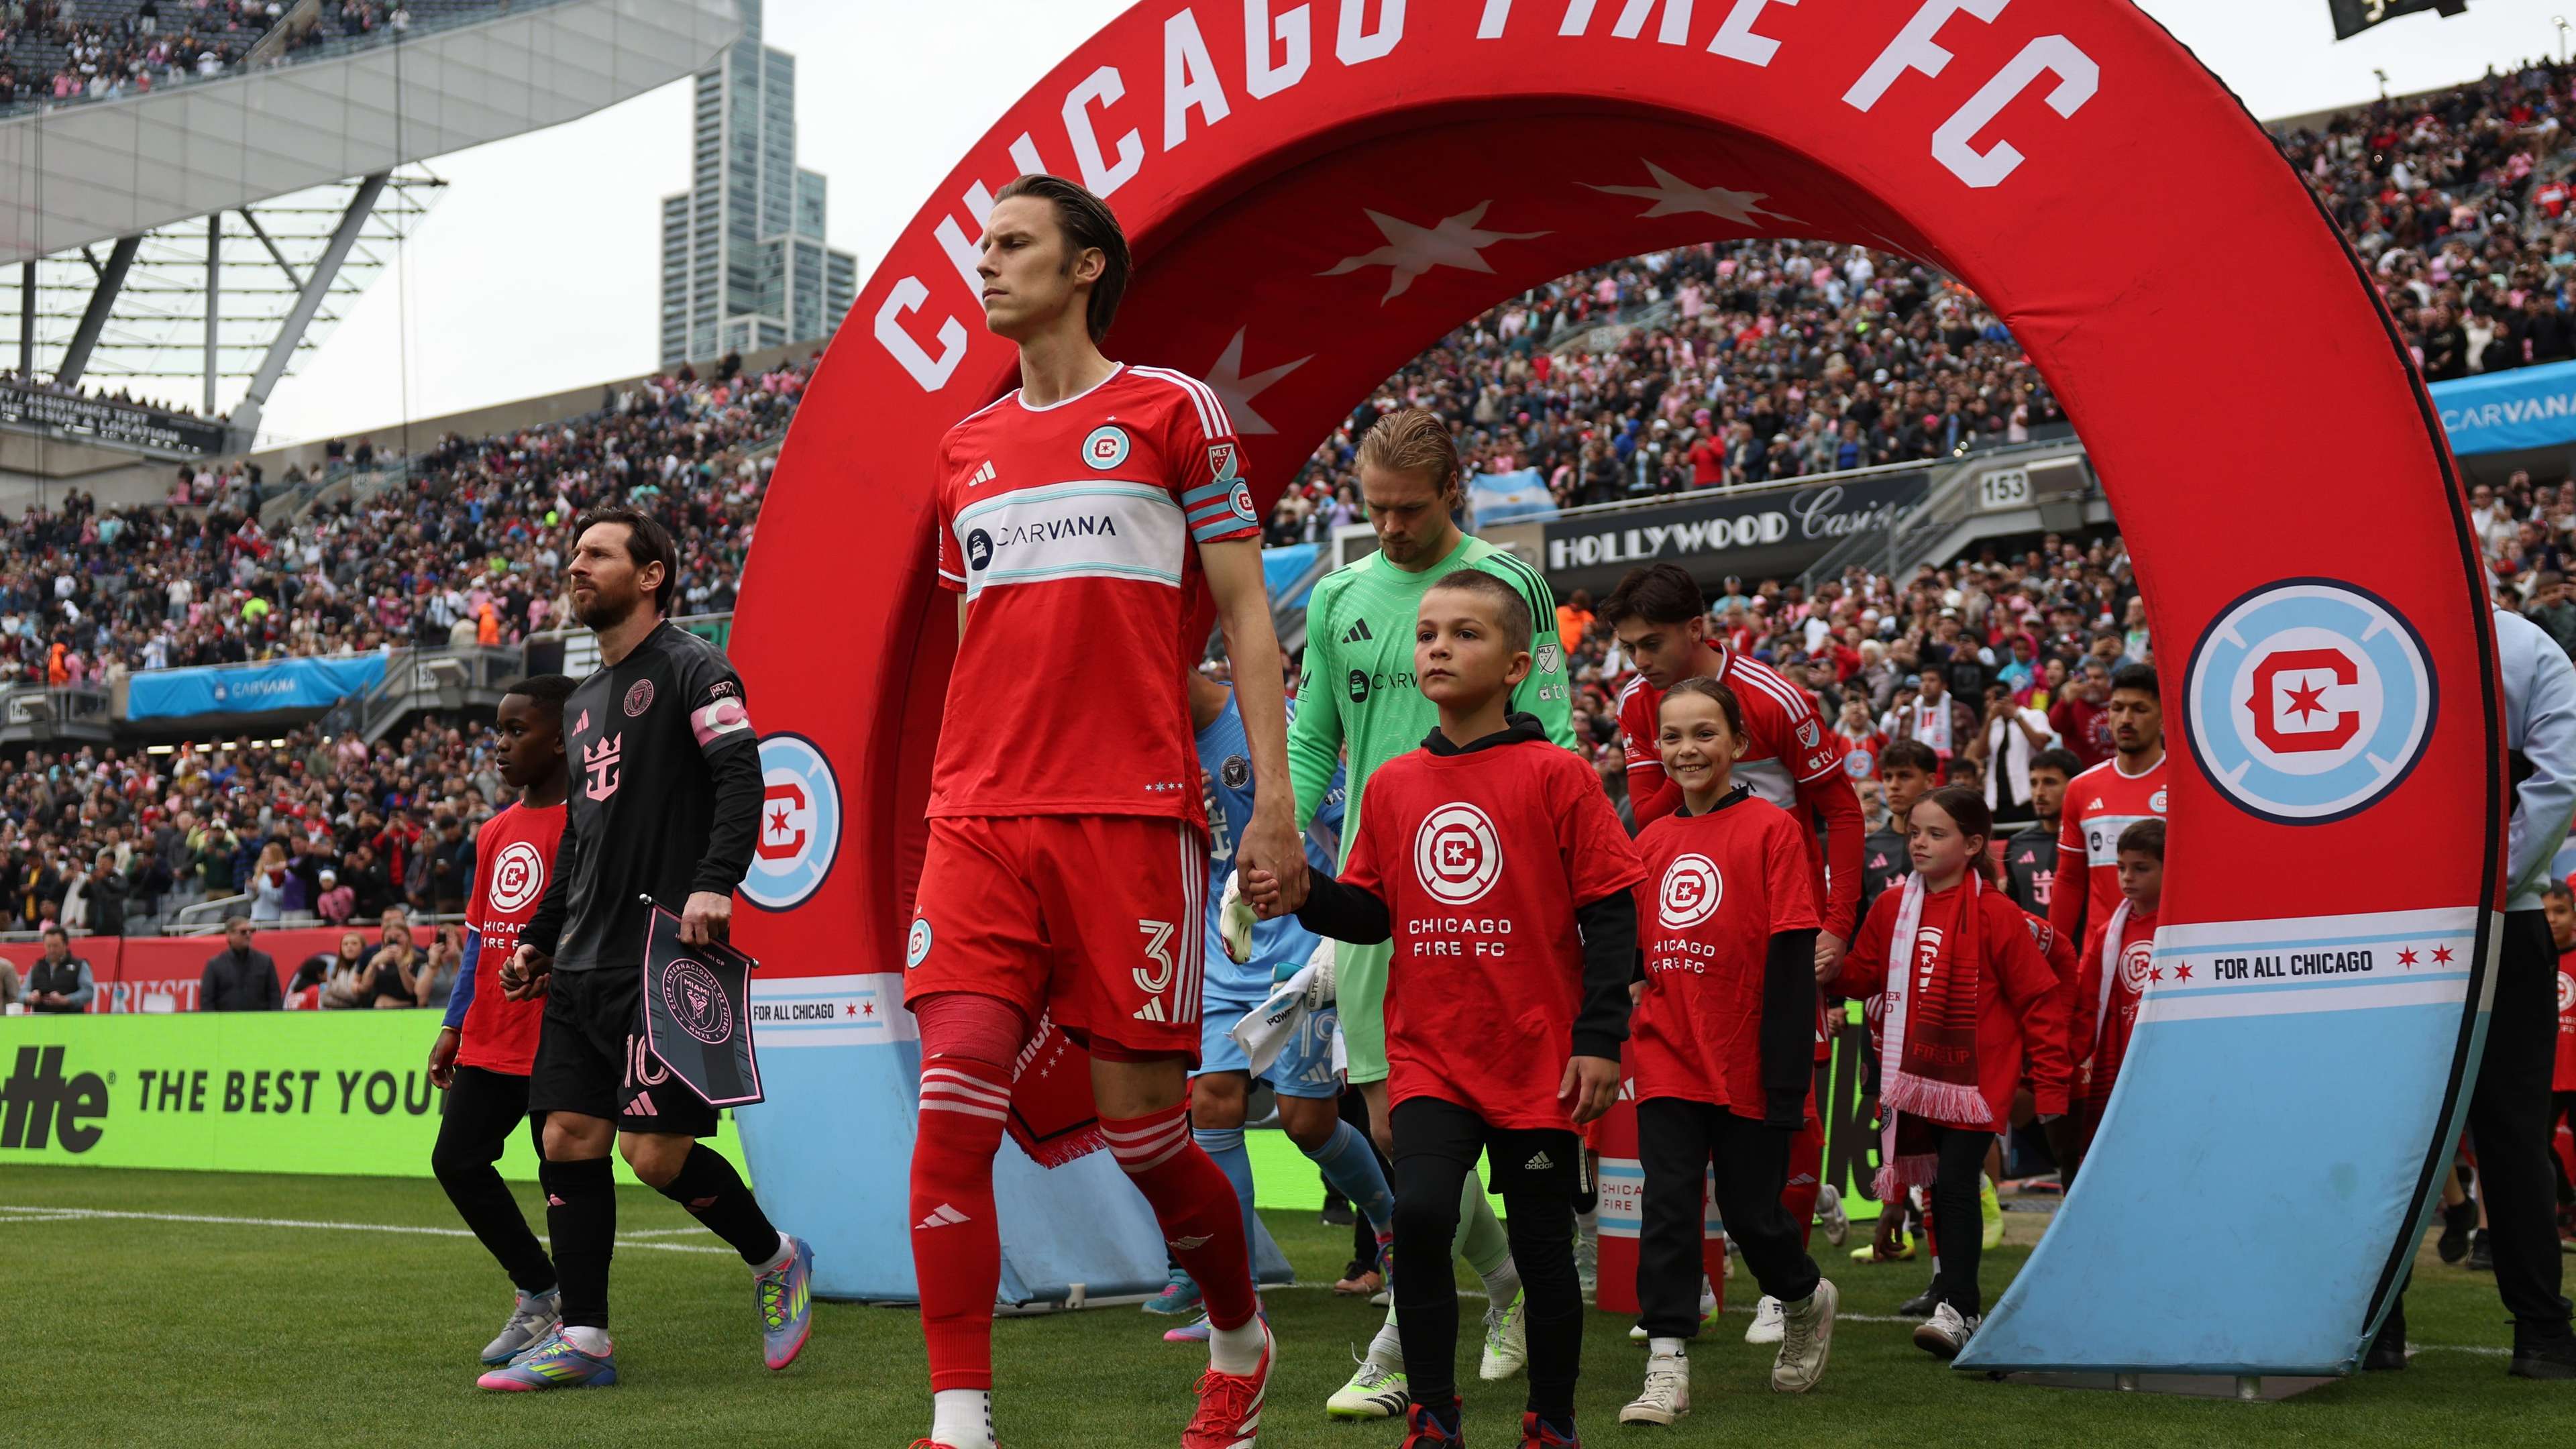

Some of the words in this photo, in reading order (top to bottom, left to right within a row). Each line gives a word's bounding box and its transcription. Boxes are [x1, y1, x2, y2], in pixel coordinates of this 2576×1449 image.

[1841, 0, 2100, 189] FC
[1212, 448, 1227, 458] MLS
[1984, 473, 2025, 501] 153
[996, 515, 1117, 546] CARVANA
[1550, 511, 1790, 570] HOLLYWOOD
[232, 677, 296, 698] CARVANA
[712, 684, 727, 694] MLS
[1372, 672, 1417, 690] CARV
[705, 696, 749, 734] C
[1799, 725, 1811, 735] MLS
[484, 920, 526, 933] HICA
[1409, 918, 1512, 934] CHICAGO
[482, 937, 505, 949] IRE
[1413, 941, 1462, 957] FIRE
[1476, 942, 1505, 957] FC
[1653, 938, 1715, 957] HICAGO
[1132, 919, 1175, 994] 3
[1652, 957, 1680, 973] FRE
[1684, 958, 1705, 974] FC
[2214, 958, 2249, 980] FOR
[2253, 955, 2286, 978] ALL
[2291, 950, 2373, 976] CHICAGO
[666, 963, 718, 990] INTERNACIONAL
[684, 978, 710, 997] MIAMI
[665, 986, 676, 1010] CLUB
[717, 992, 724, 1004] DE
[753, 1006, 771, 1020] FOR
[773, 1005, 790, 1020] ALL
[793, 1003, 835, 1020] CHICAGO
[688, 1024, 712, 1040] MMXX
[1300, 1012, 1336, 1058] 19
[624, 1033, 669, 1089] 10
[138, 1070, 207, 1112] THE
[223, 1070, 319, 1114] BEST
[1525, 1162, 1554, 1170] adidas
[1602, 1183, 1642, 1195] CHICA
[1604, 1199, 1632, 1211] FIRE
